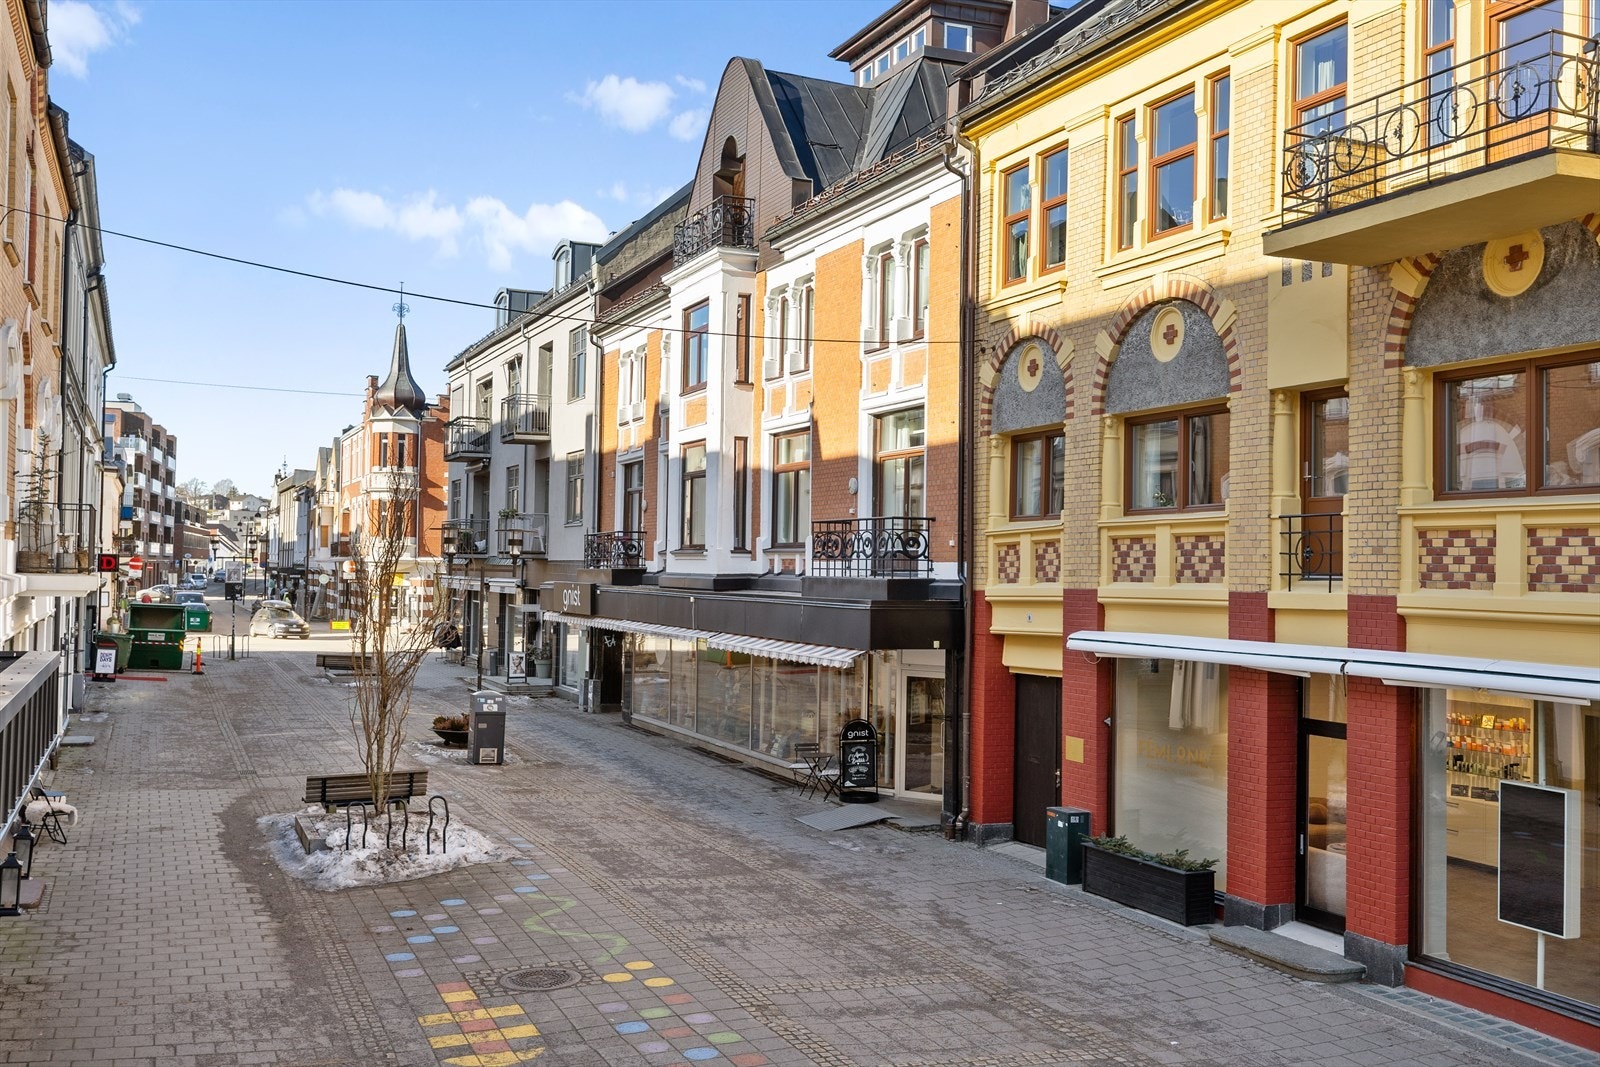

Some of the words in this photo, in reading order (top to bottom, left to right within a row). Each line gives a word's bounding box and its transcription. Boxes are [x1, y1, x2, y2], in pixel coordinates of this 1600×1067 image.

[101, 556, 115, 569] D
[563, 584, 581, 611] gnist
[847, 729, 868, 738] gnist
